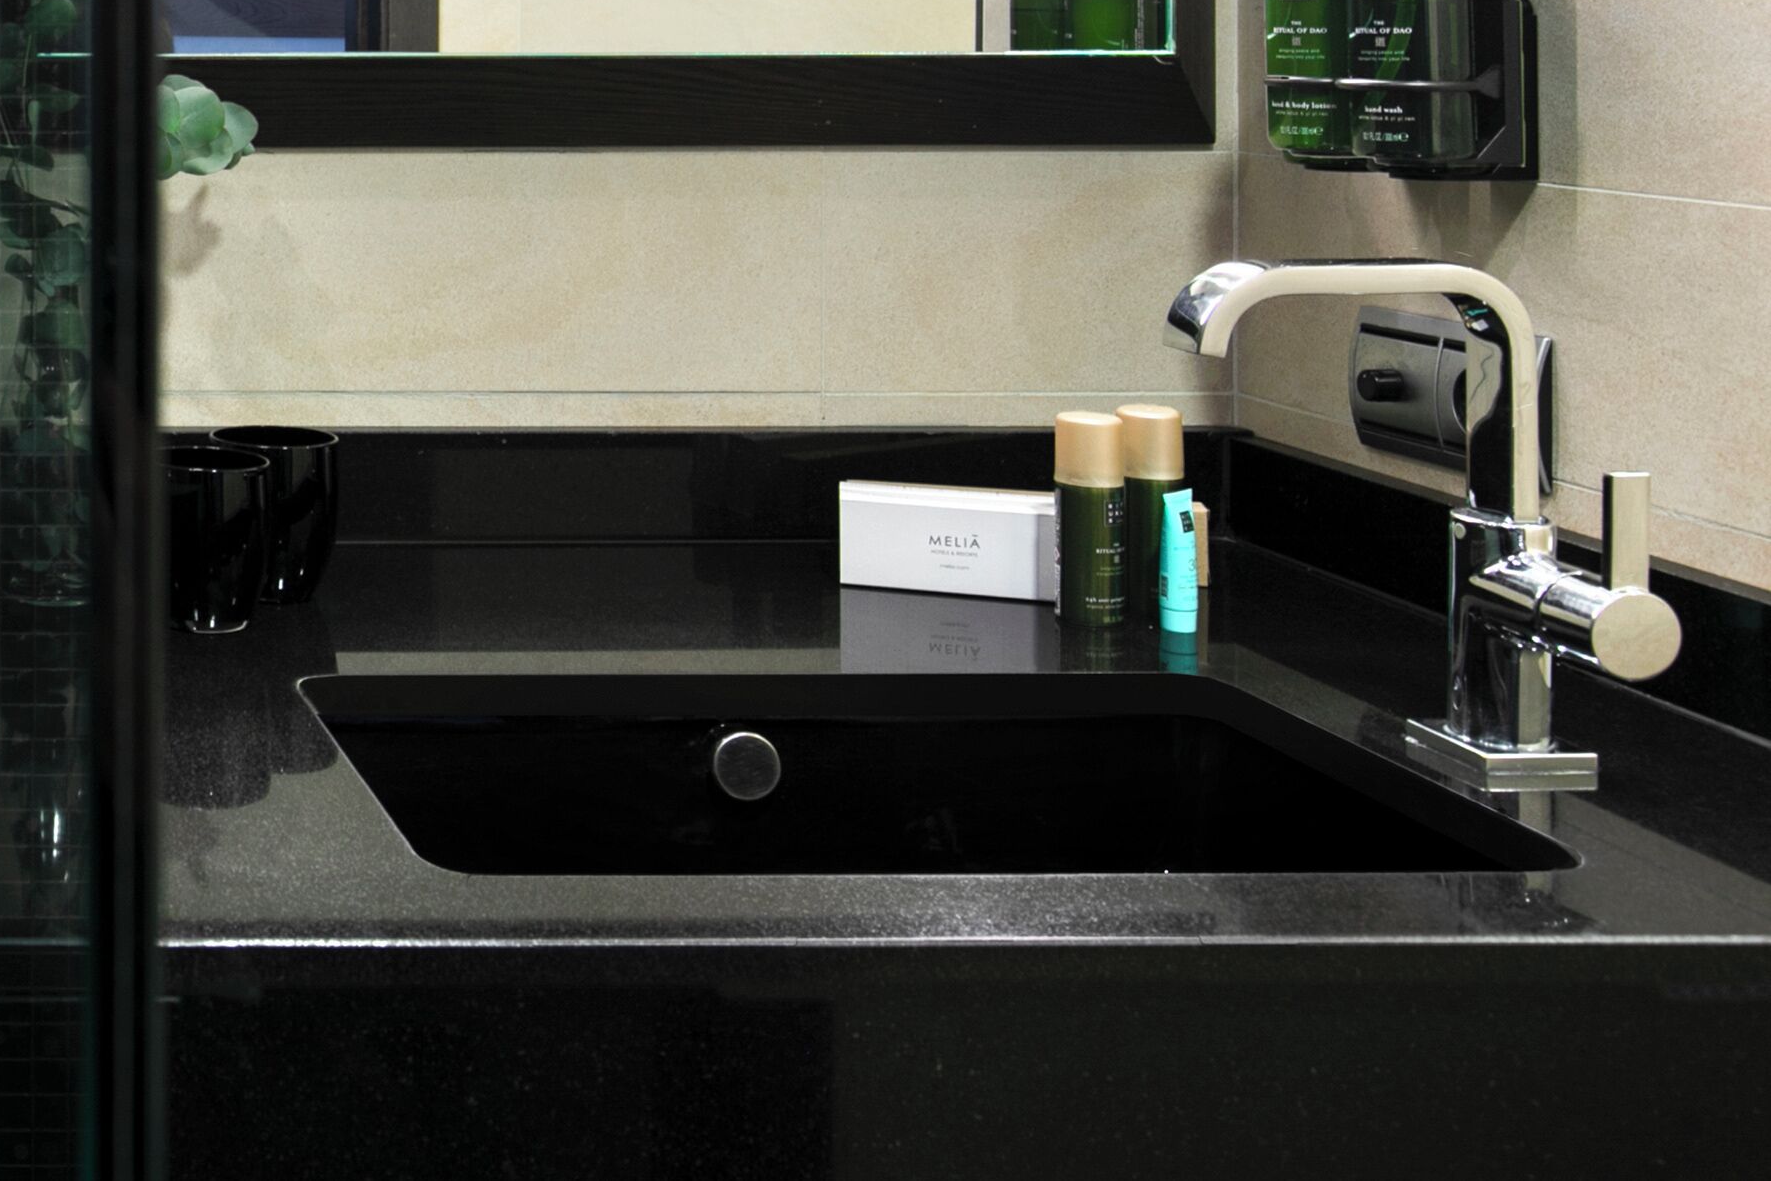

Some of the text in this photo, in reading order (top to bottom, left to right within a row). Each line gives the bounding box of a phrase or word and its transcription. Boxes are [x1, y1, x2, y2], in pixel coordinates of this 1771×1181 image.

[1292, 101, 1310, 110] body
[1311, 101, 1337, 109] lotion
[1383, 106, 1403, 114] wash
